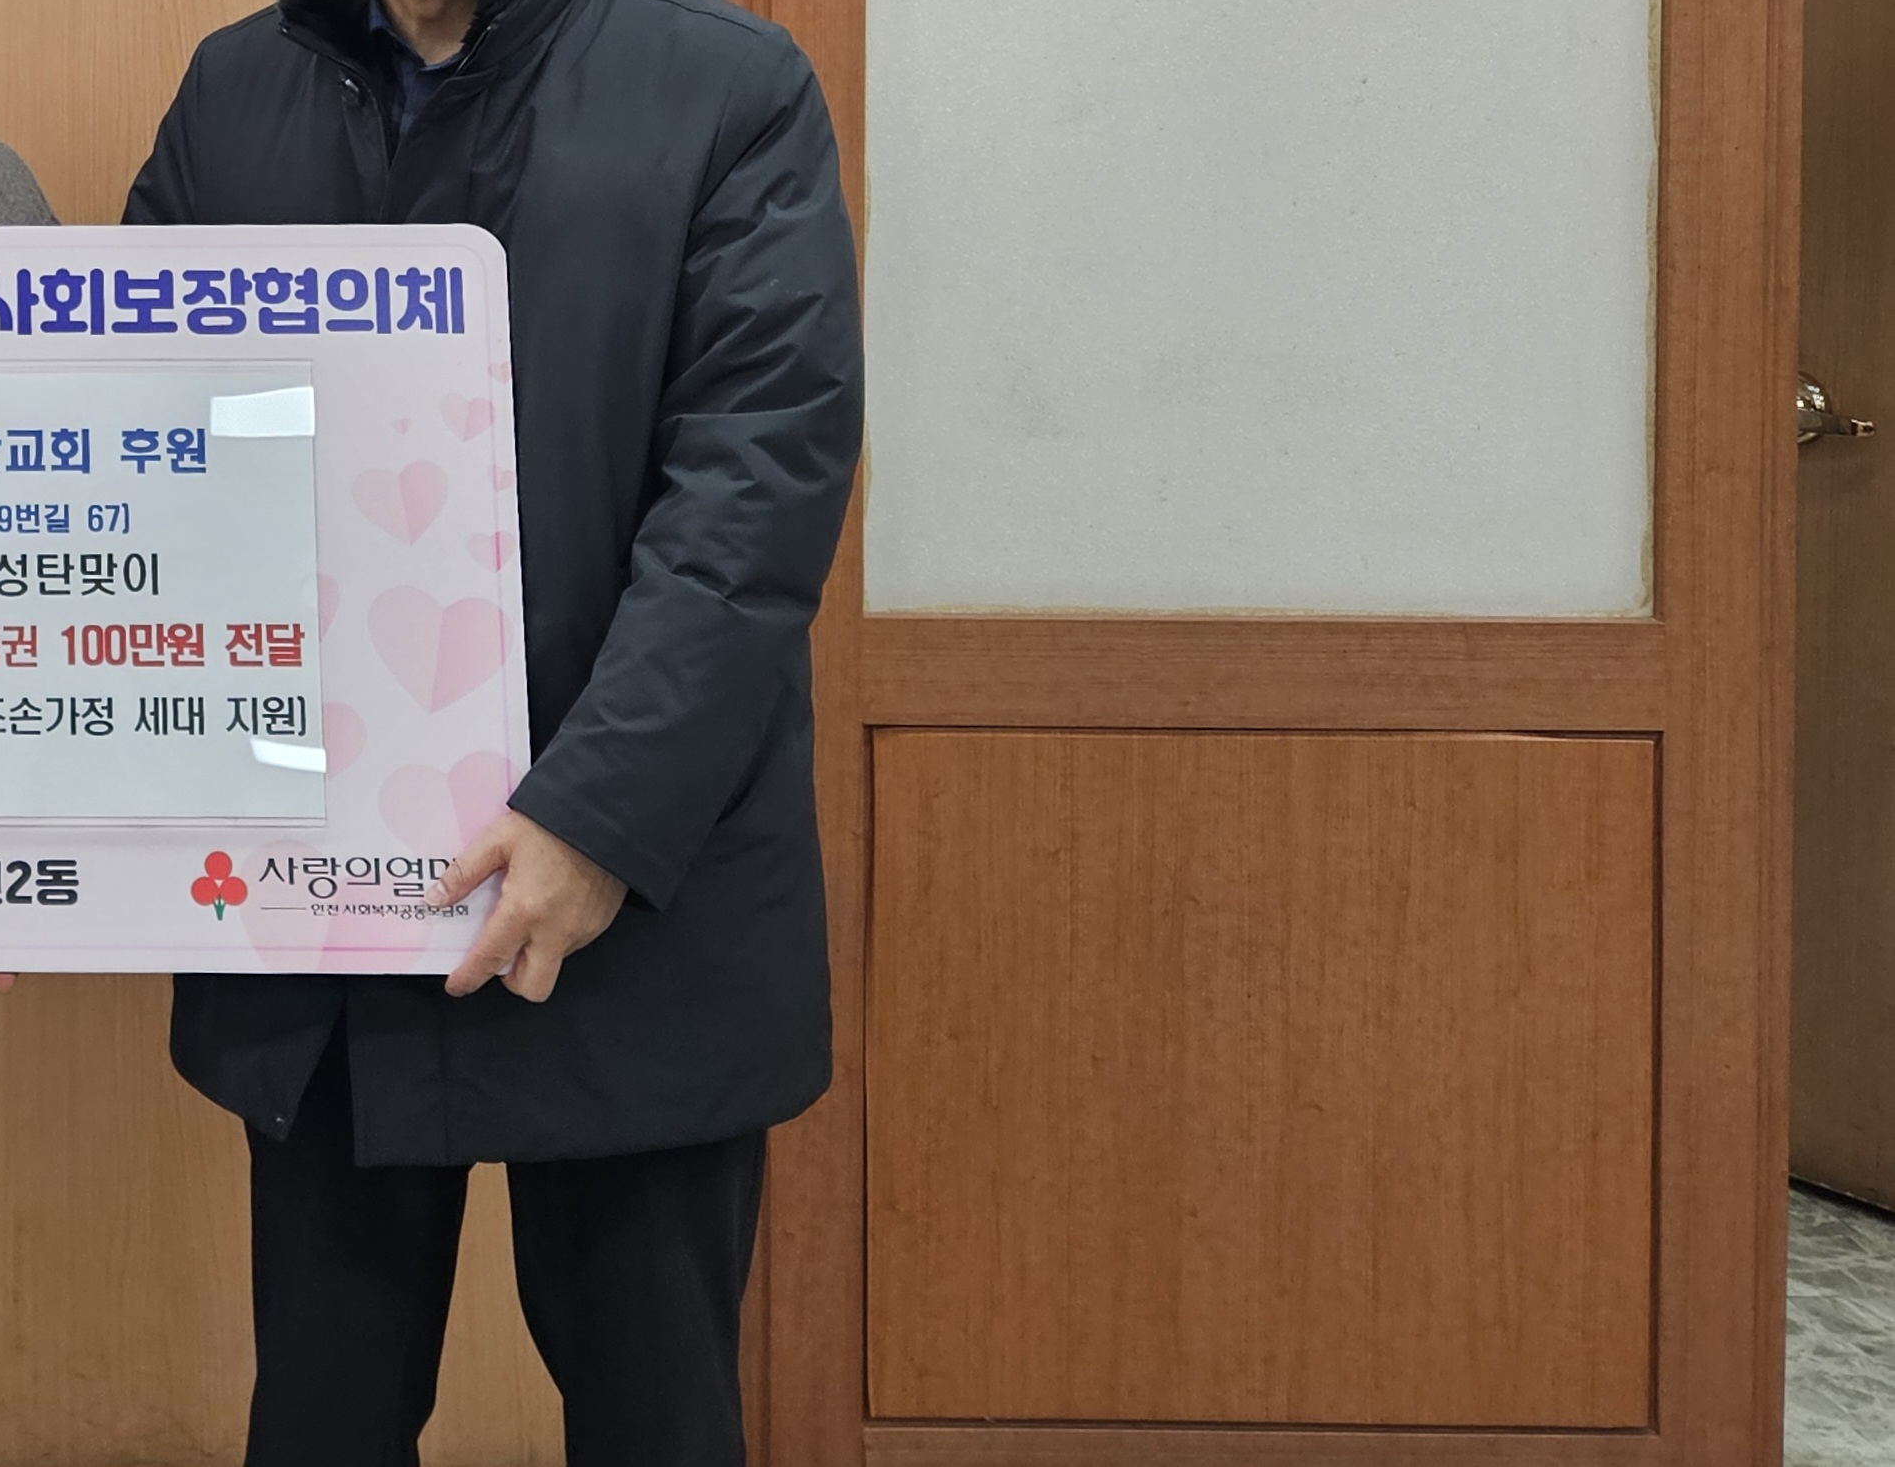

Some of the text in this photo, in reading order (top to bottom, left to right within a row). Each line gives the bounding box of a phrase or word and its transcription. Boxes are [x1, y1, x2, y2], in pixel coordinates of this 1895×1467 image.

[119, 428, 207, 475] 후원
[60, 623, 206, 668] 100만원
[224, 623, 306, 668] 전달
[133, 696, 206, 737] 세대
